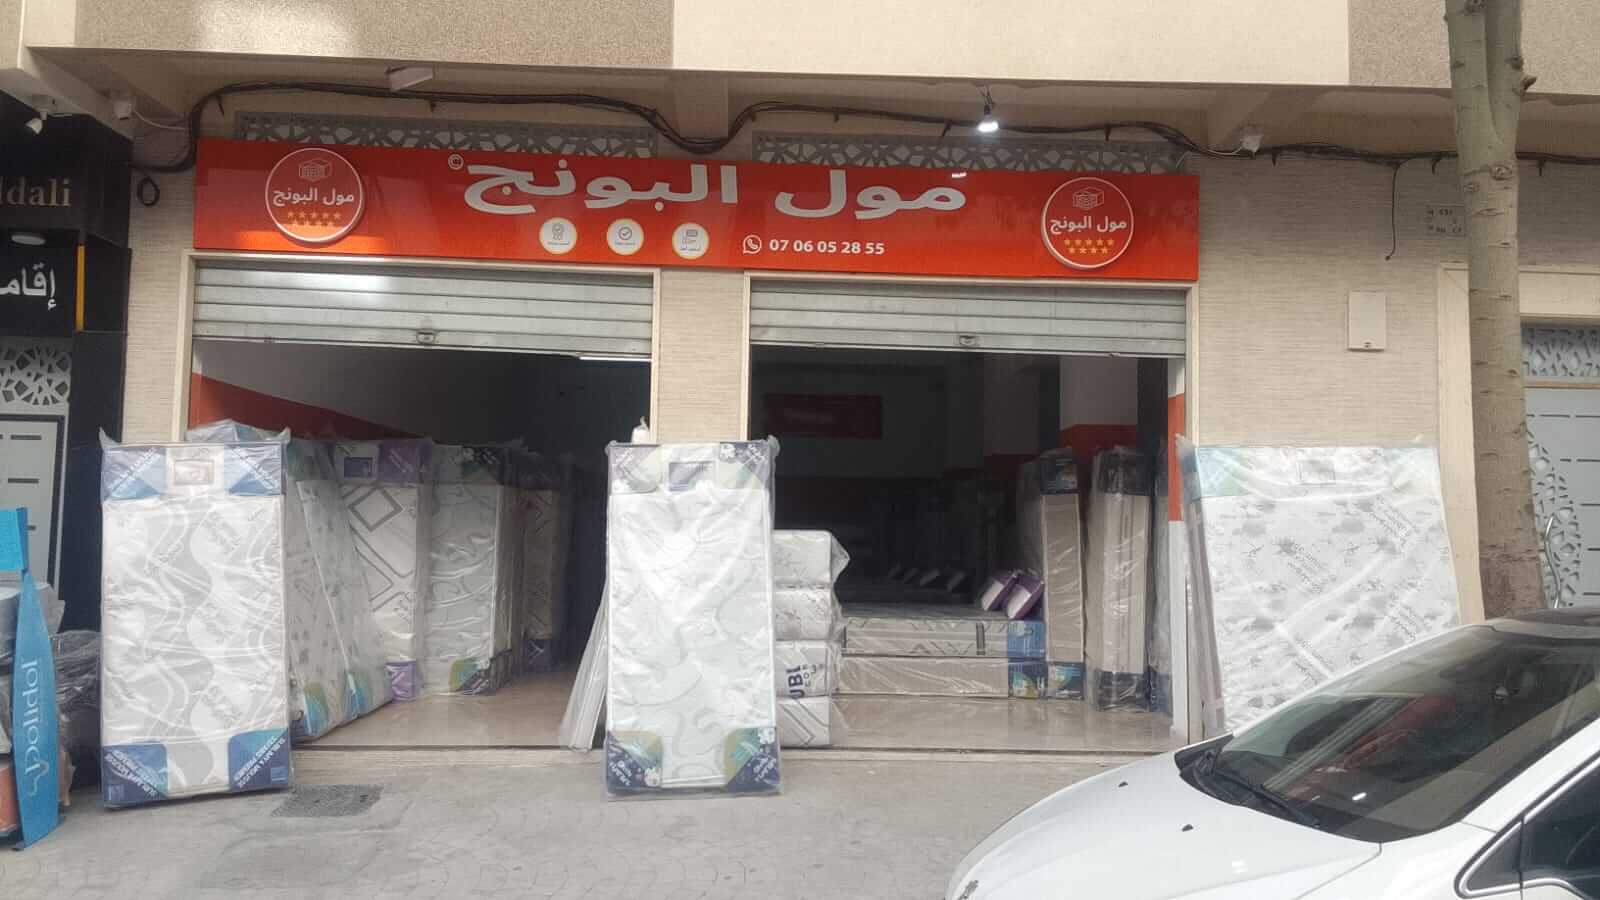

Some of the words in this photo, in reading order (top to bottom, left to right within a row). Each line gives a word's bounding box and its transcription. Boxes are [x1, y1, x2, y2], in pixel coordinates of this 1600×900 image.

[0, 175, 72, 207] dali
[463, 157, 738, 216] البونج
[774, 170, 967, 220] مول
[271, 187, 318, 209] البونج
[322, 189, 355, 208] مول
[1049, 214, 1092, 236] البونج
[1096, 216, 1127, 234] مول
[769, 239, 789, 251] 07
[793, 239, 814, 253] 06
[816, 240, 837, 254] 05
[841, 241, 861, 254] 28
[865, 242, 885, 255] 55
